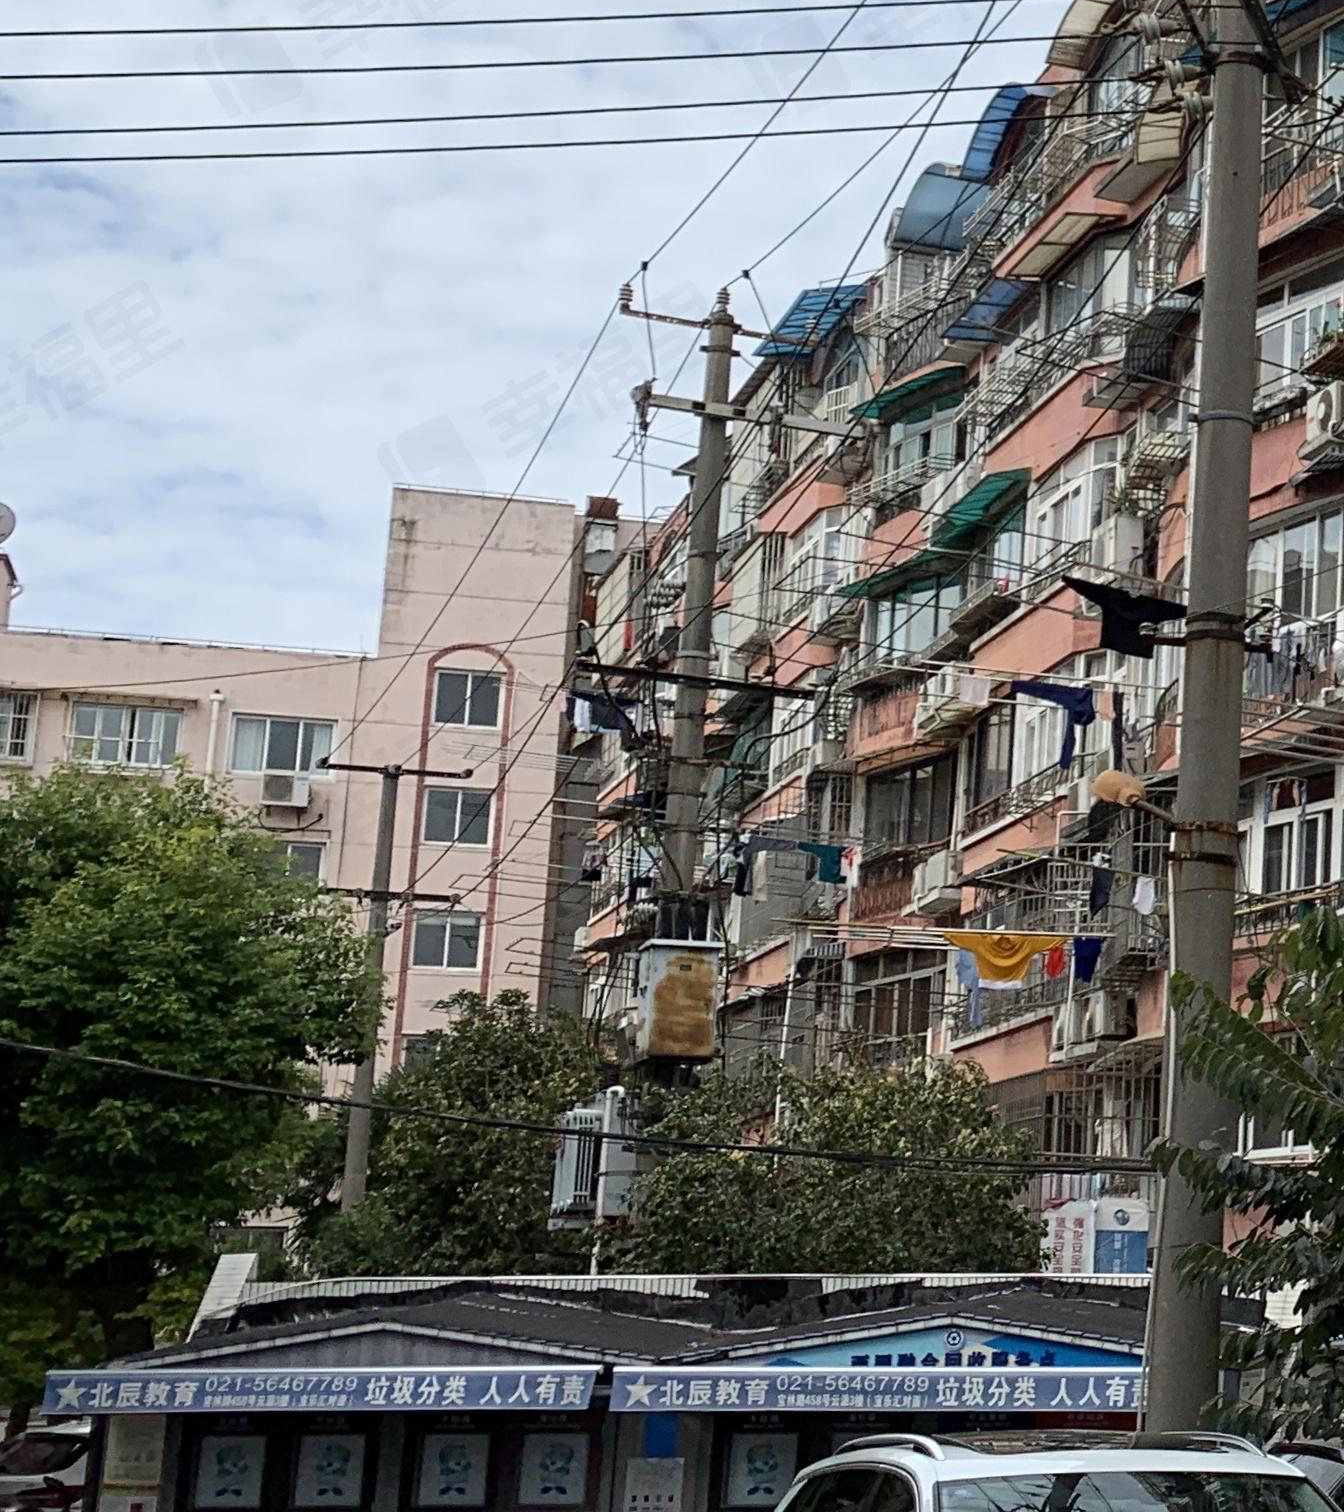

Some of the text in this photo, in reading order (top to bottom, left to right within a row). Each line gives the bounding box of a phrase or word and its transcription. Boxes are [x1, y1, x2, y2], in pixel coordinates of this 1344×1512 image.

[88, 1381, 200, 1408] 北辰教育
[204, 1375, 358, 1392] 021-56467789
[363, 1374, 586, 1406] 垃圾分类 人人有责
[658, 1378, 771, 1407] 北辰教育
[776, 1374, 930, 1392] 021-56467789
[936, 1375, 1037, 1407] 垃圾分类
